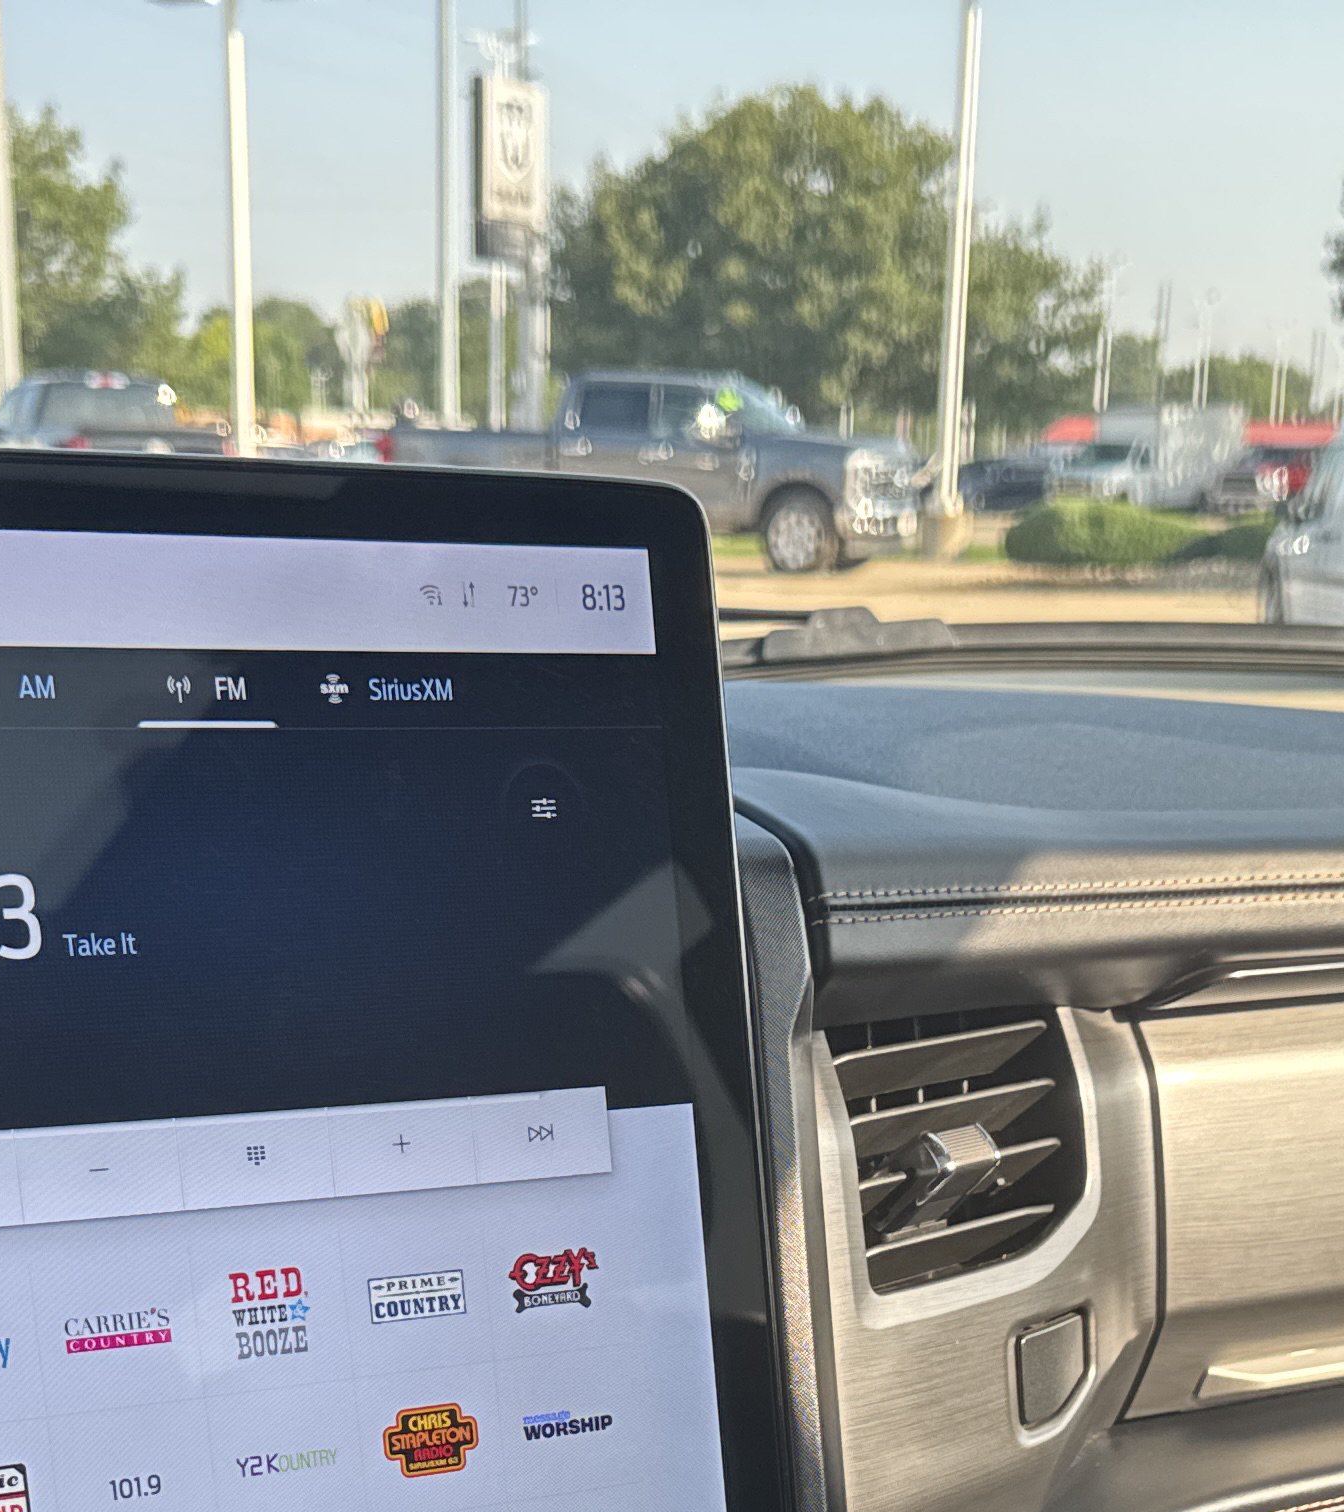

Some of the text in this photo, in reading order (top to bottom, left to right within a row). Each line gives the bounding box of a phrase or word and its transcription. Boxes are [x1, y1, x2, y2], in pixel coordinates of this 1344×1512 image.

[507, 585, 538, 607] 73°
[581, 583, 626, 611] 8:13
[18, 674, 56, 700] AM
[214, 675, 247, 701] FM
[368, 677, 454, 702] SiriusXM
[62, 932, 138, 957] Take It
[386, 1276, 446, 1292] PRIME
[374, 1293, 461, 1319] COUNTRY
[523, 1290, 581, 1308] BONEYARD
[64, 1306, 171, 1338] CARRIE'S
[232, 1303, 288, 1327] WHITE
[68, 1329, 170, 1352] COUNTRY
[235, 1325, 309, 1360] BOOZE
[408, 1411, 452, 1432] CHRIS
[522, 1414, 613, 1441] WORSHIP
[391, 1425, 472, 1452] STAPLETON
[413, 1444, 454, 1462] RADIO
[108, 1474, 162, 1501] 101.9
